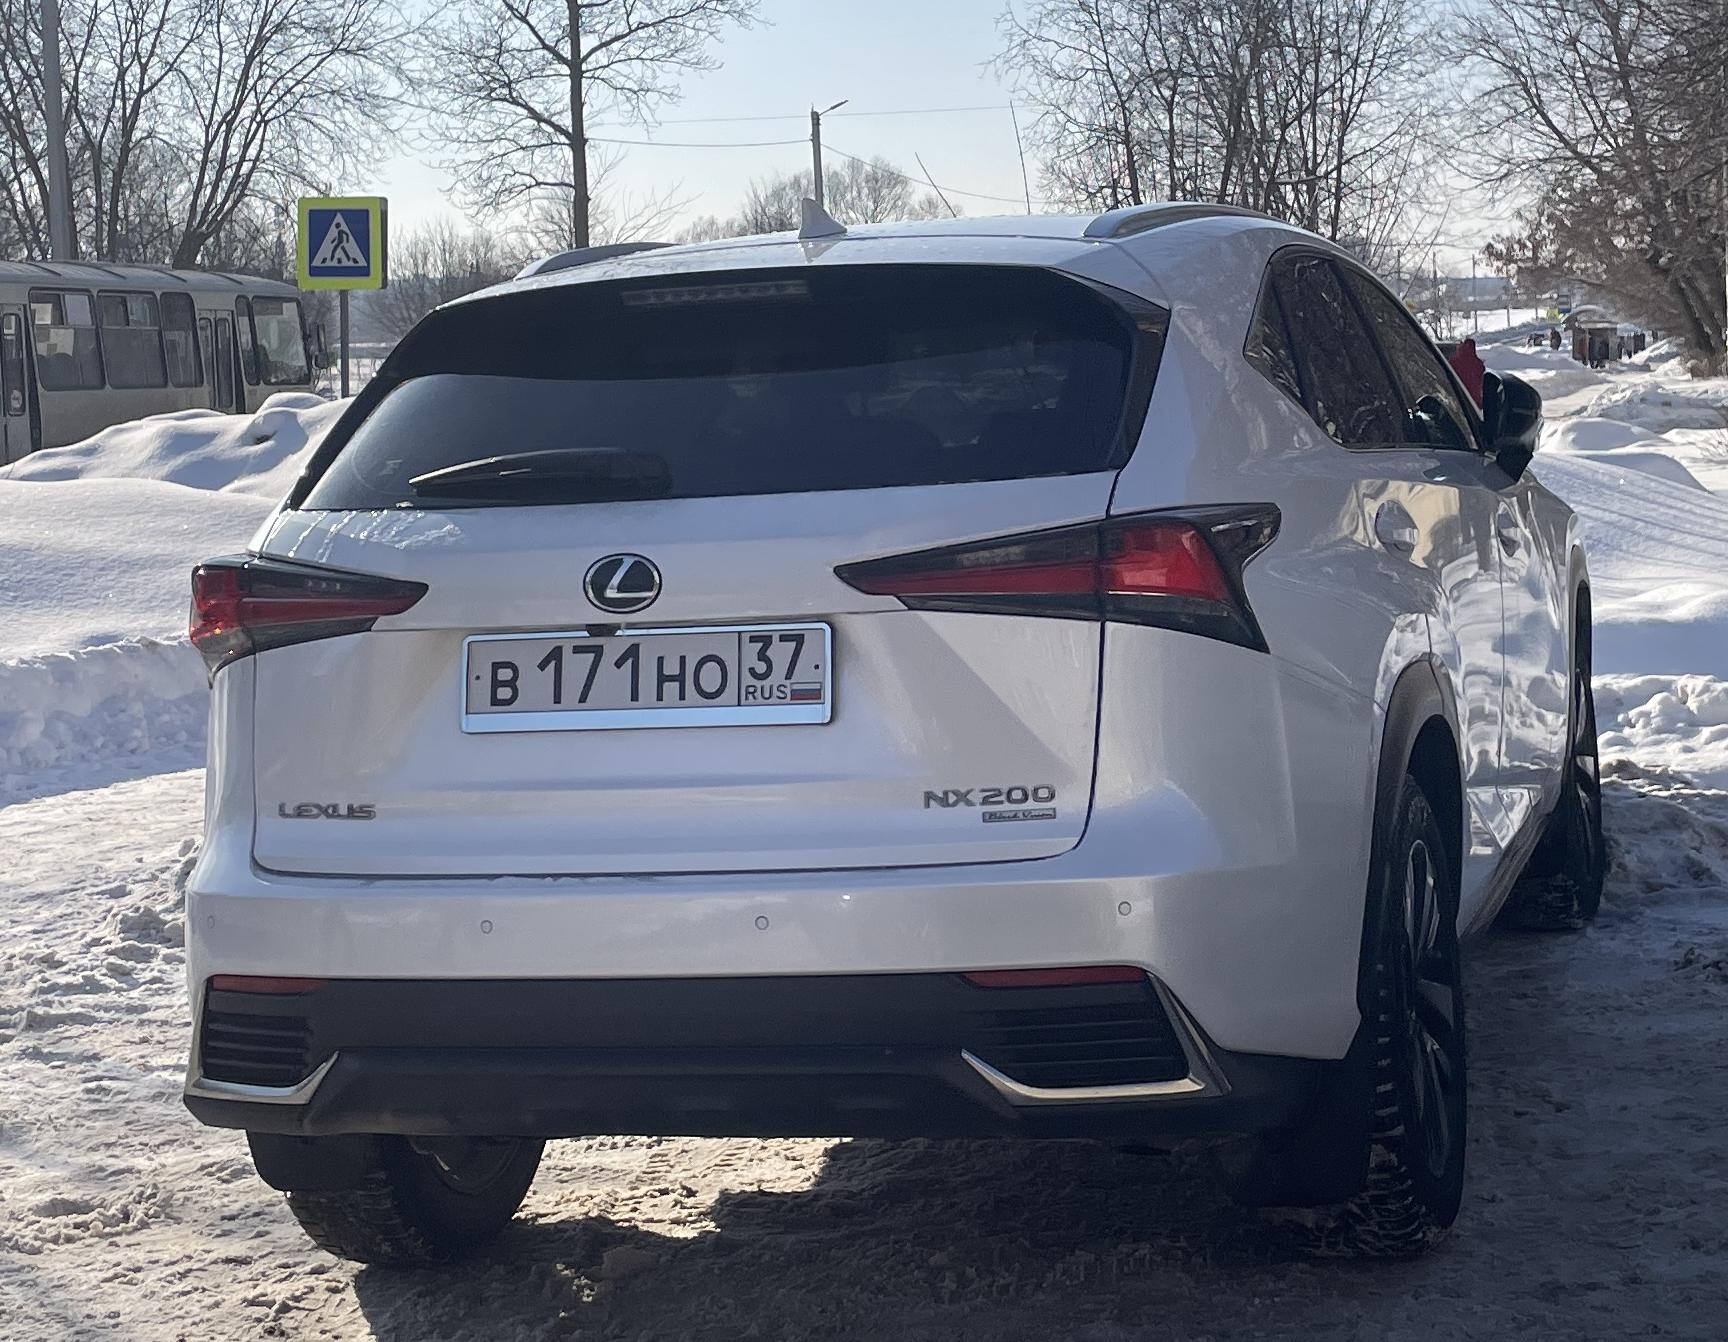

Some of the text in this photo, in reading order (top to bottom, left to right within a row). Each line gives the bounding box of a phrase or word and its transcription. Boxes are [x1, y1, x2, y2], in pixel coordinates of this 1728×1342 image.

[748, 633, 806, 681] 37
[745, 685, 788, 702] RUS
[278, 802, 377, 820] LEXUS
